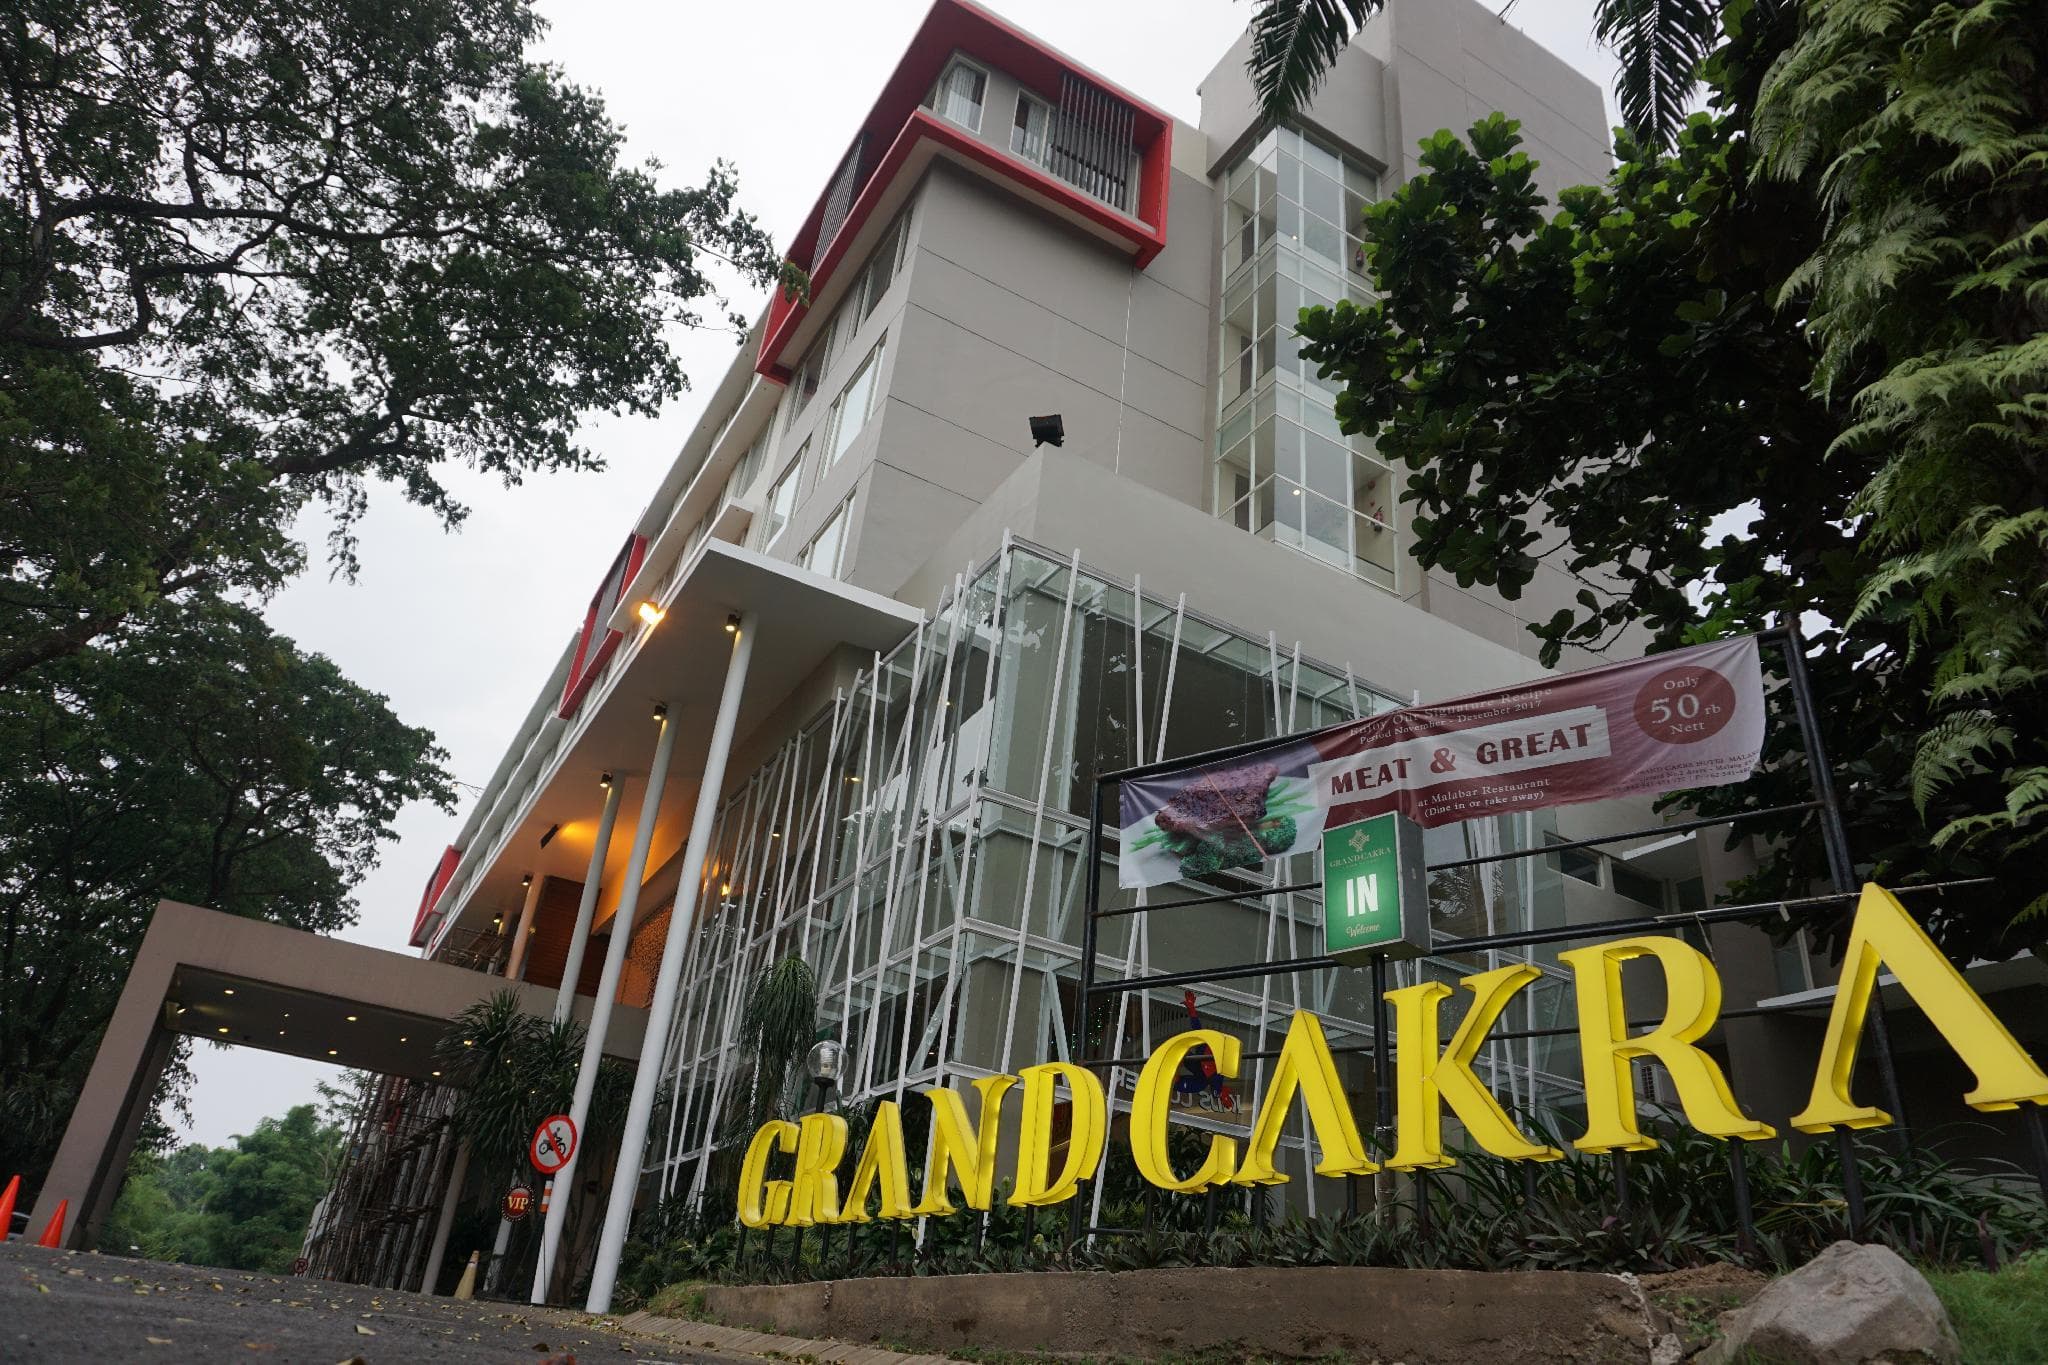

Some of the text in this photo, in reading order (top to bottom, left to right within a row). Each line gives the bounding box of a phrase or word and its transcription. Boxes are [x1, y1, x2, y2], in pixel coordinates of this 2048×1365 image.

[1663, 676, 1700, 690] Only
[1350, 687, 1553, 737] Enjoy Our Signature Recipe
[1359, 730, 1392, 745] Period
[1394, 719, 1446, 735] November
[1457, 707, 1510, 723] Desember
[1514, 699, 1542, 712] 2017
[1651, 693, 1721, 724] 50 rb
[1669, 721, 1705, 735] Nett
[1331, 723, 1592, 796] MEAT & GREAT
[1416, 778, 1551, 807] at Malabar Restaurant
[1424, 790, 1545, 818] (Dine in or take away)
[1346, 873, 1379, 917] IN
[1345, 922, 1381, 938] Welcome
[738, 1060, 1107, 1229] GRAND
[507, 1195, 529, 1210] VIP
